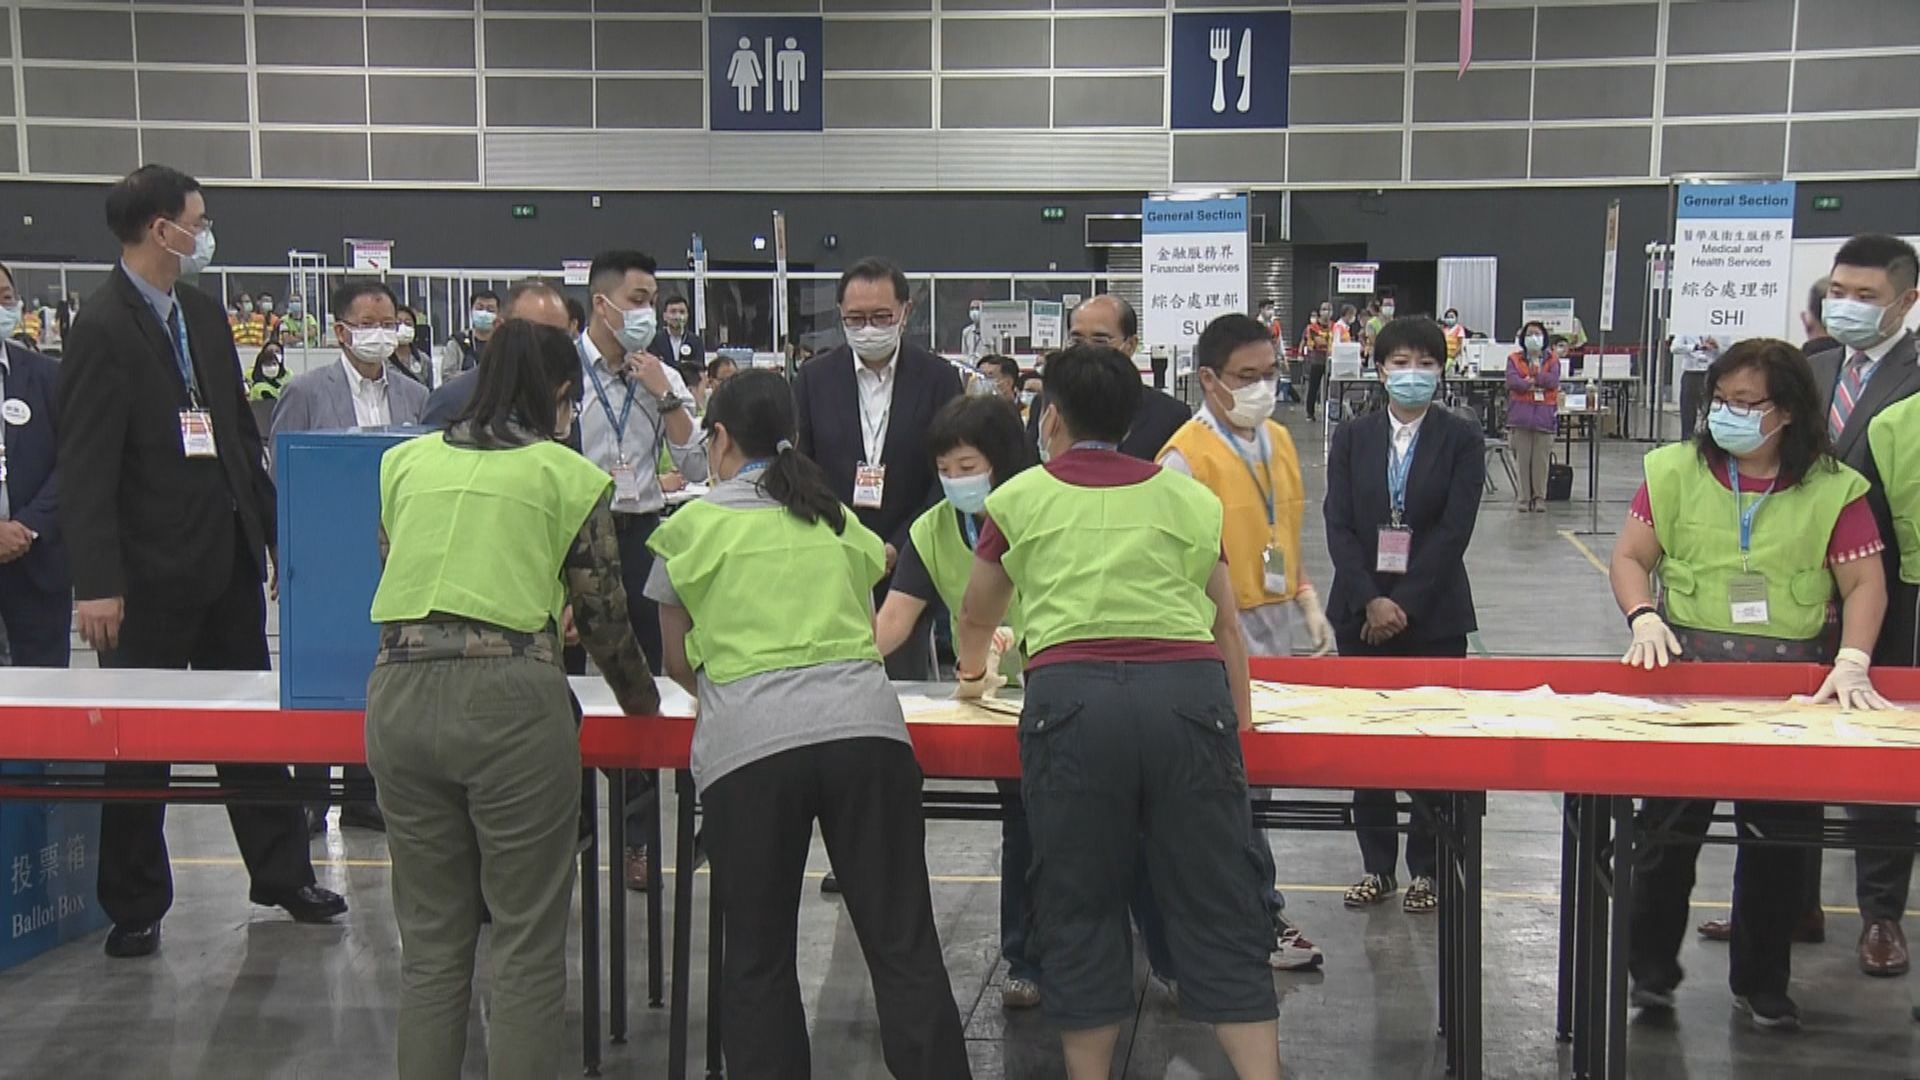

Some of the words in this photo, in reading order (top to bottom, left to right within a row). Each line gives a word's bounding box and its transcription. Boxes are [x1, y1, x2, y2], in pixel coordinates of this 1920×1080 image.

[1683, 195, 1734, 207] General
[1738, 195, 1788, 206] Section
[1147, 211, 1194, 221] General
[1197, 209, 1242, 220] Section
[1157, 245, 1234, 261] 金融服務界
[1701, 244, 1741, 254] Medical
[1743, 245, 1764, 254] and
[1150, 264, 1195, 274] Financial
[1197, 263, 1240, 273] Services
[1691, 258, 1725, 268] Health
[1727, 257, 1772, 267] Services
[1681, 280, 1778, 298] 綜合處理部
[1151, 292, 1239, 309] 綜合處理部
[1710, 309, 1744, 326] SHI
[11, 833, 85, 896] 投票箱
[12, 904, 55, 939] Ballot
[58, 895, 86, 919] Box
